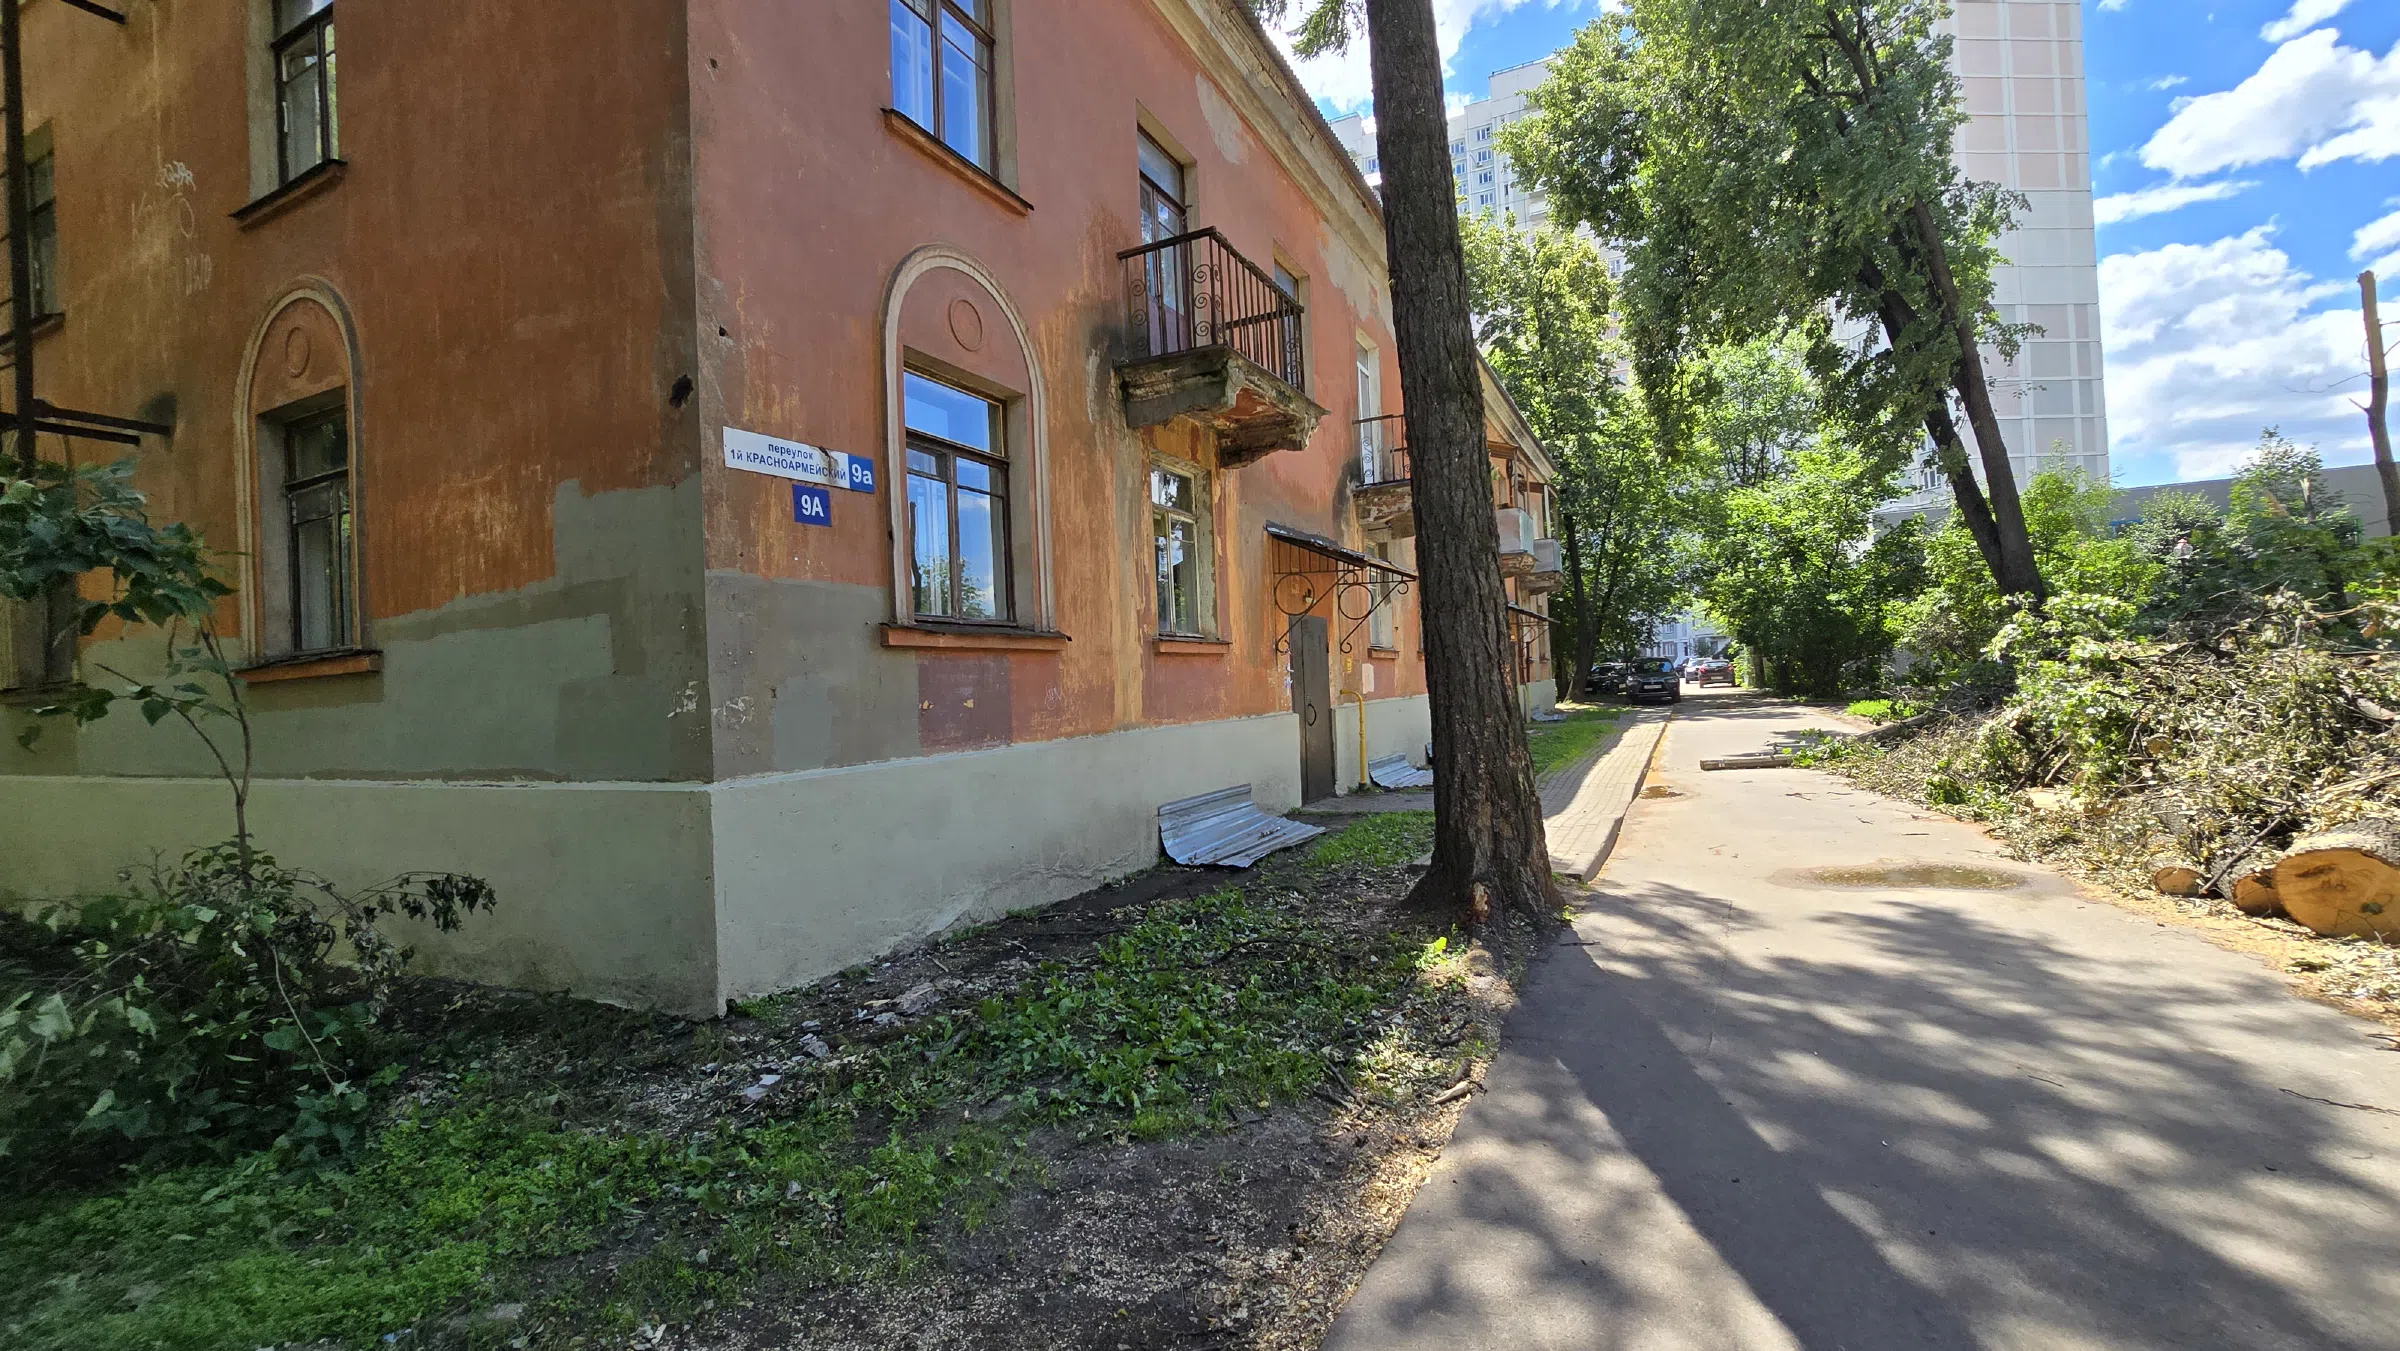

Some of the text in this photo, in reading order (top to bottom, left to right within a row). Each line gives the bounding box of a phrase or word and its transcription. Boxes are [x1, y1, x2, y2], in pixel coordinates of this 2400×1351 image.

[768, 443, 813, 460] переулок
[730, 449, 847, 480] 1й КРАСНОАРМЕЙСКИЙ
[851, 464, 873, 485] 9а
[801, 495, 825, 517] 9А
